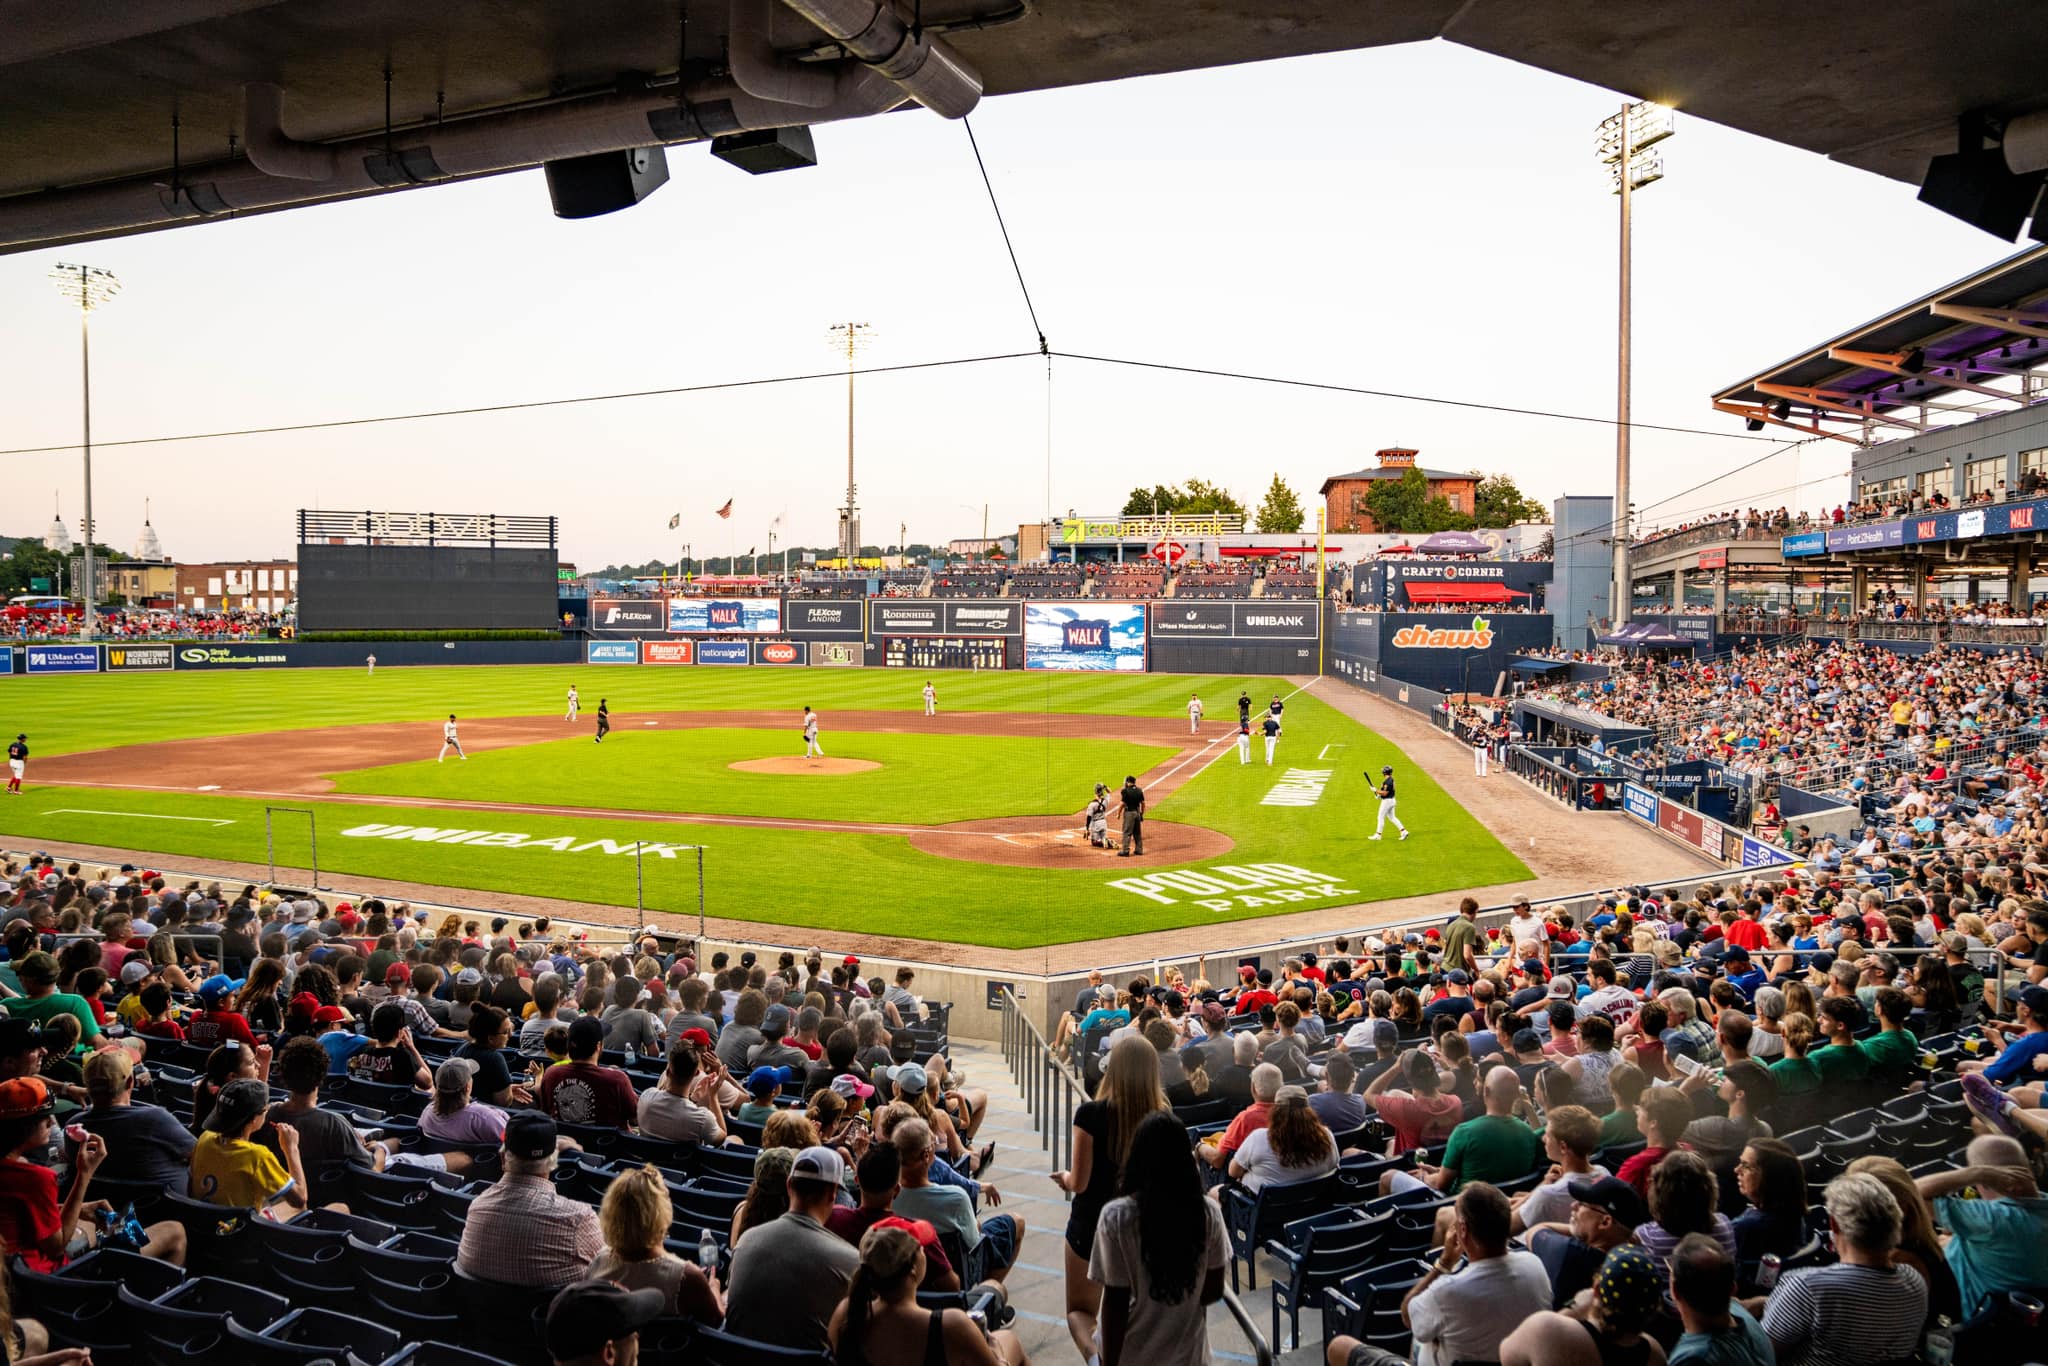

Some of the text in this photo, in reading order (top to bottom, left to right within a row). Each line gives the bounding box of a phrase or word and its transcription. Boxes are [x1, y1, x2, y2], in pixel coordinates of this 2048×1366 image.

[2010, 507, 2033, 529] WALK
[1917, 520, 1936, 539] WALK
[1401, 567, 1504, 577] CRAFT CORNER
[711, 609, 738, 623] WALK
[1247, 615, 1304, 626] UNIBANK
[1068, 628, 1103, 646] WALK
[210, 648, 230, 657] Simply
[650, 645, 686, 656] Manny's
[702, 648, 745, 659] nationalgrid
[767, 649, 793, 658] Hood
[48, 653, 95, 661] UMass Chan
[126, 657, 163, 666] BREWERY
[340, 823, 709, 860] UNIBANK
[1104, 863, 1346, 905] POLAR
[1192, 884, 1360, 912] PARK
